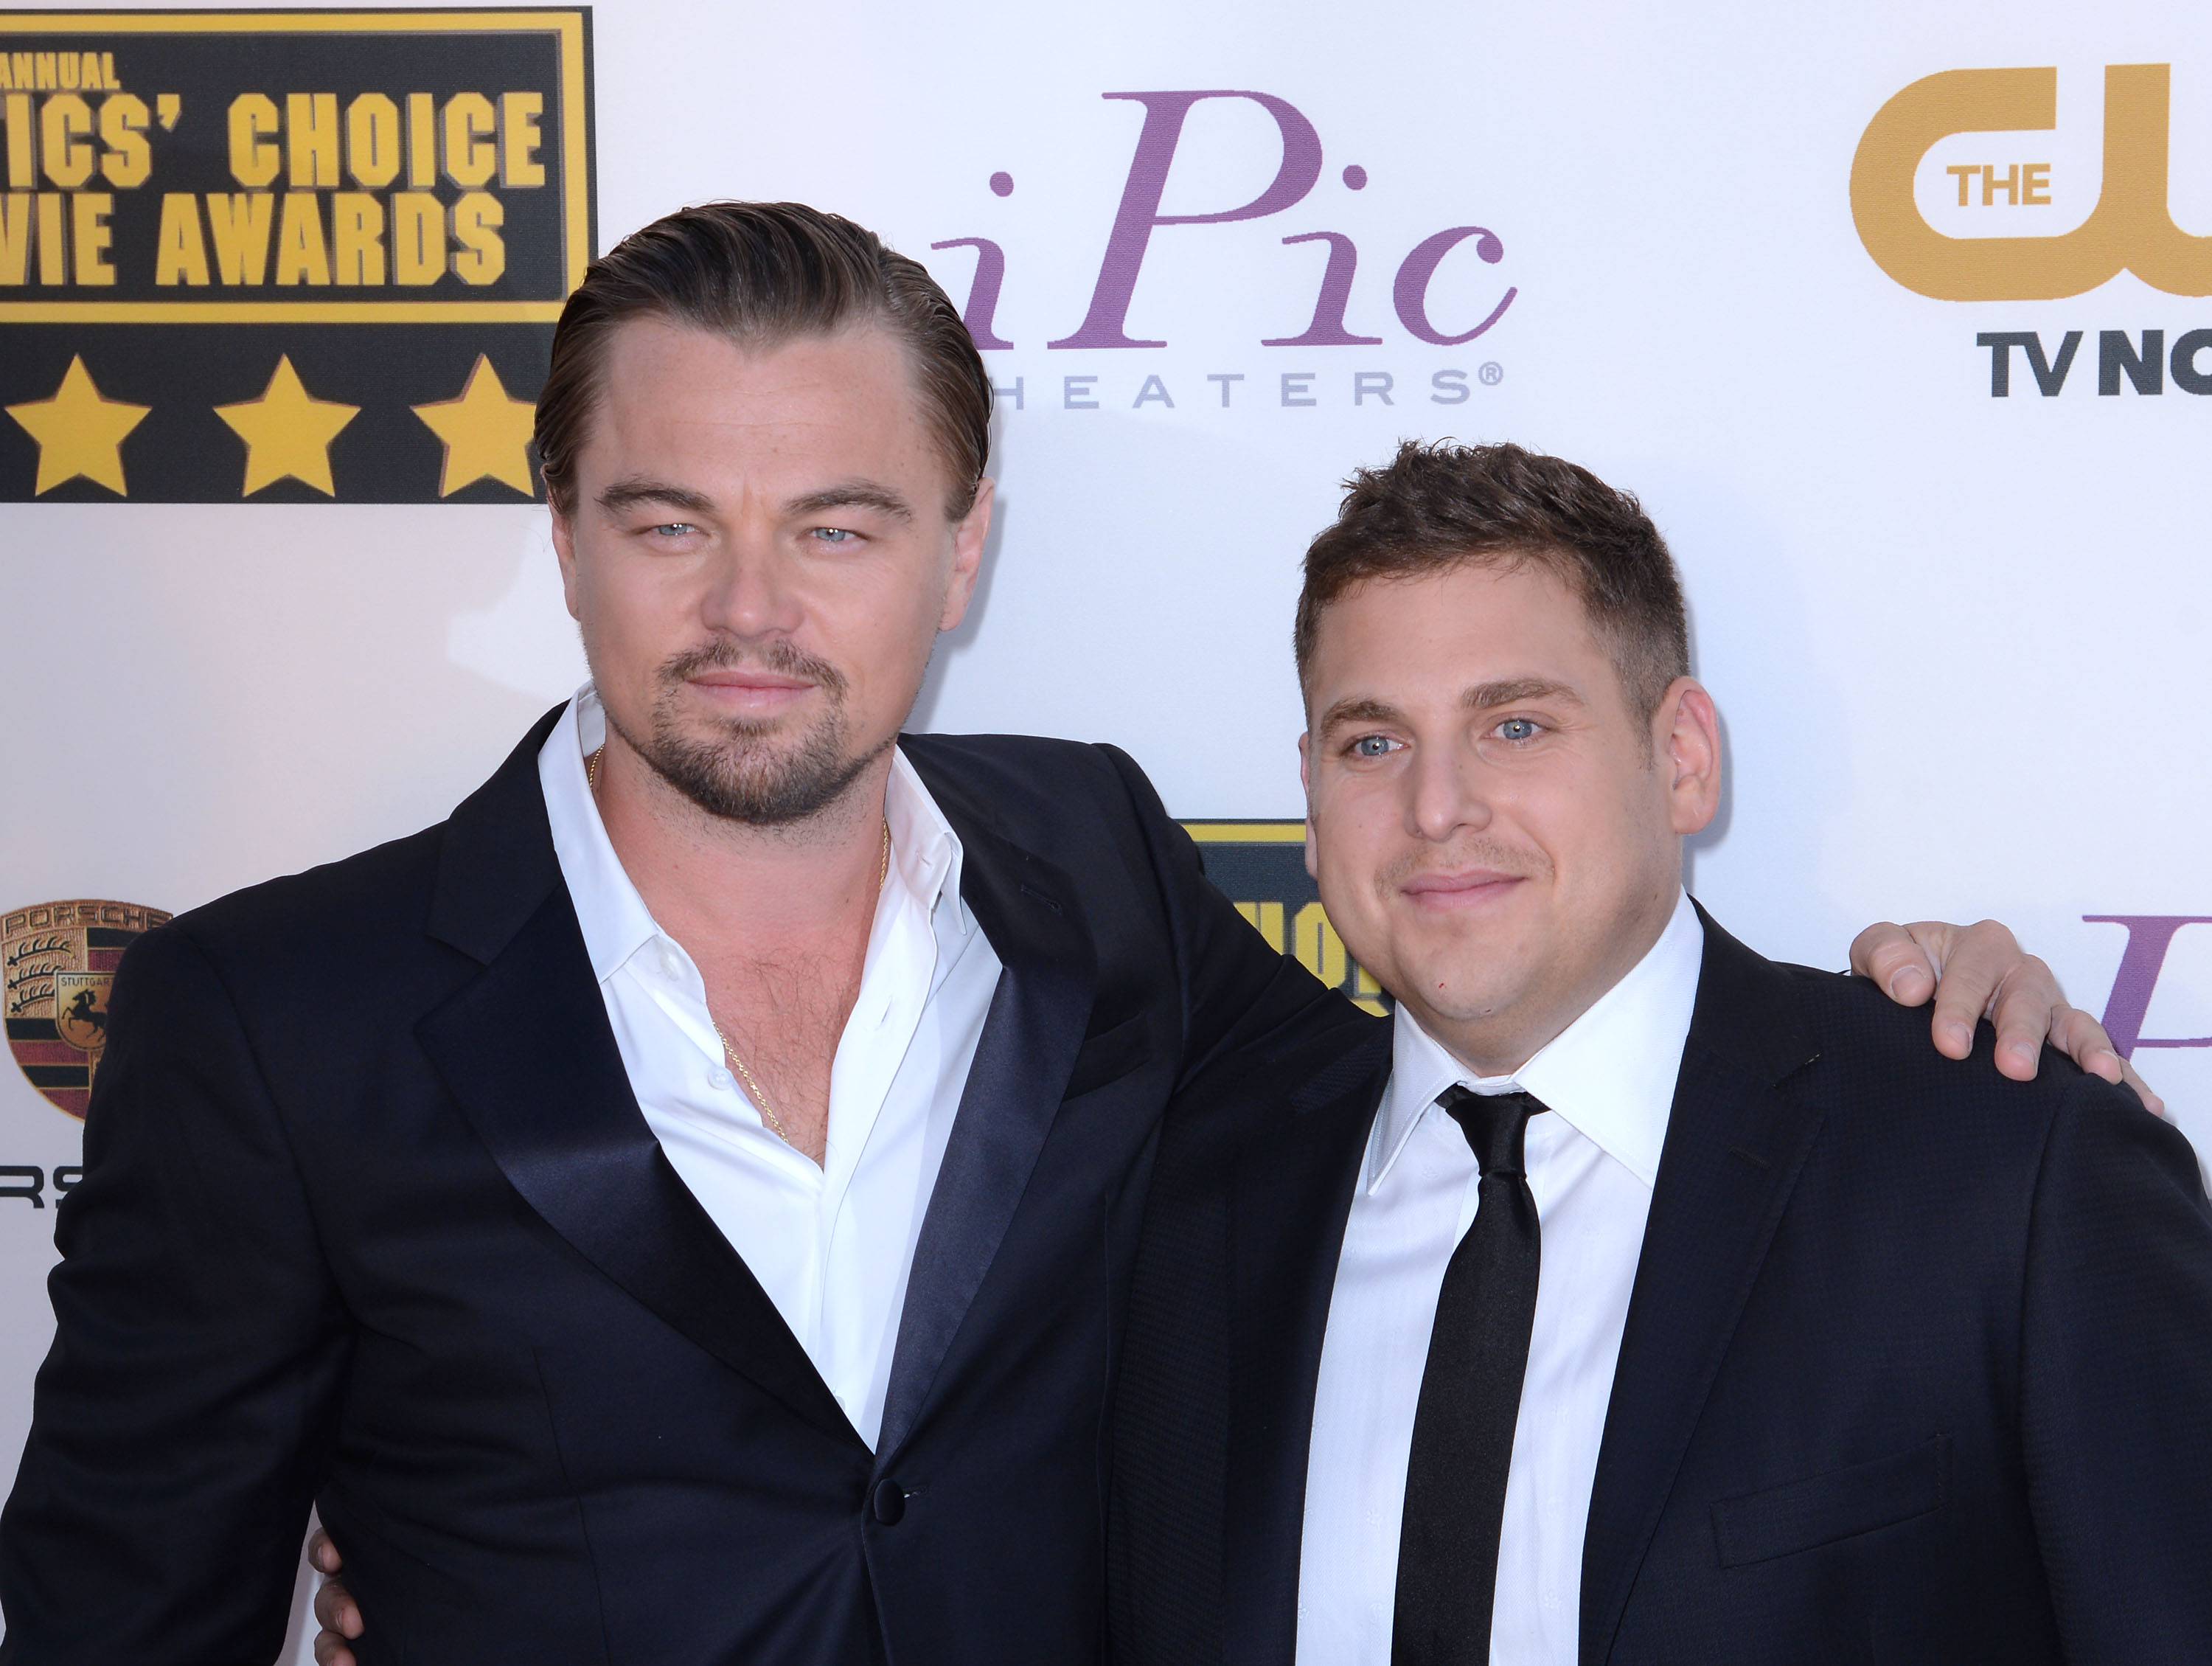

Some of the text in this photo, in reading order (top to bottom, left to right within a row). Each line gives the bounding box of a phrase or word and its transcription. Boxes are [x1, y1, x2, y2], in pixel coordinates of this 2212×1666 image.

[0, 52, 121, 90] ANNUAL
[0, 92, 546, 190] ICS' CHOICE
[1946, 163, 2052, 206] THE
[155, 192, 506, 286] AWARDS
[931, 89, 1518, 350] iPic
[1976, 330, 2084, 398] TV
[60, 976, 111, 987] STUTTGAR
